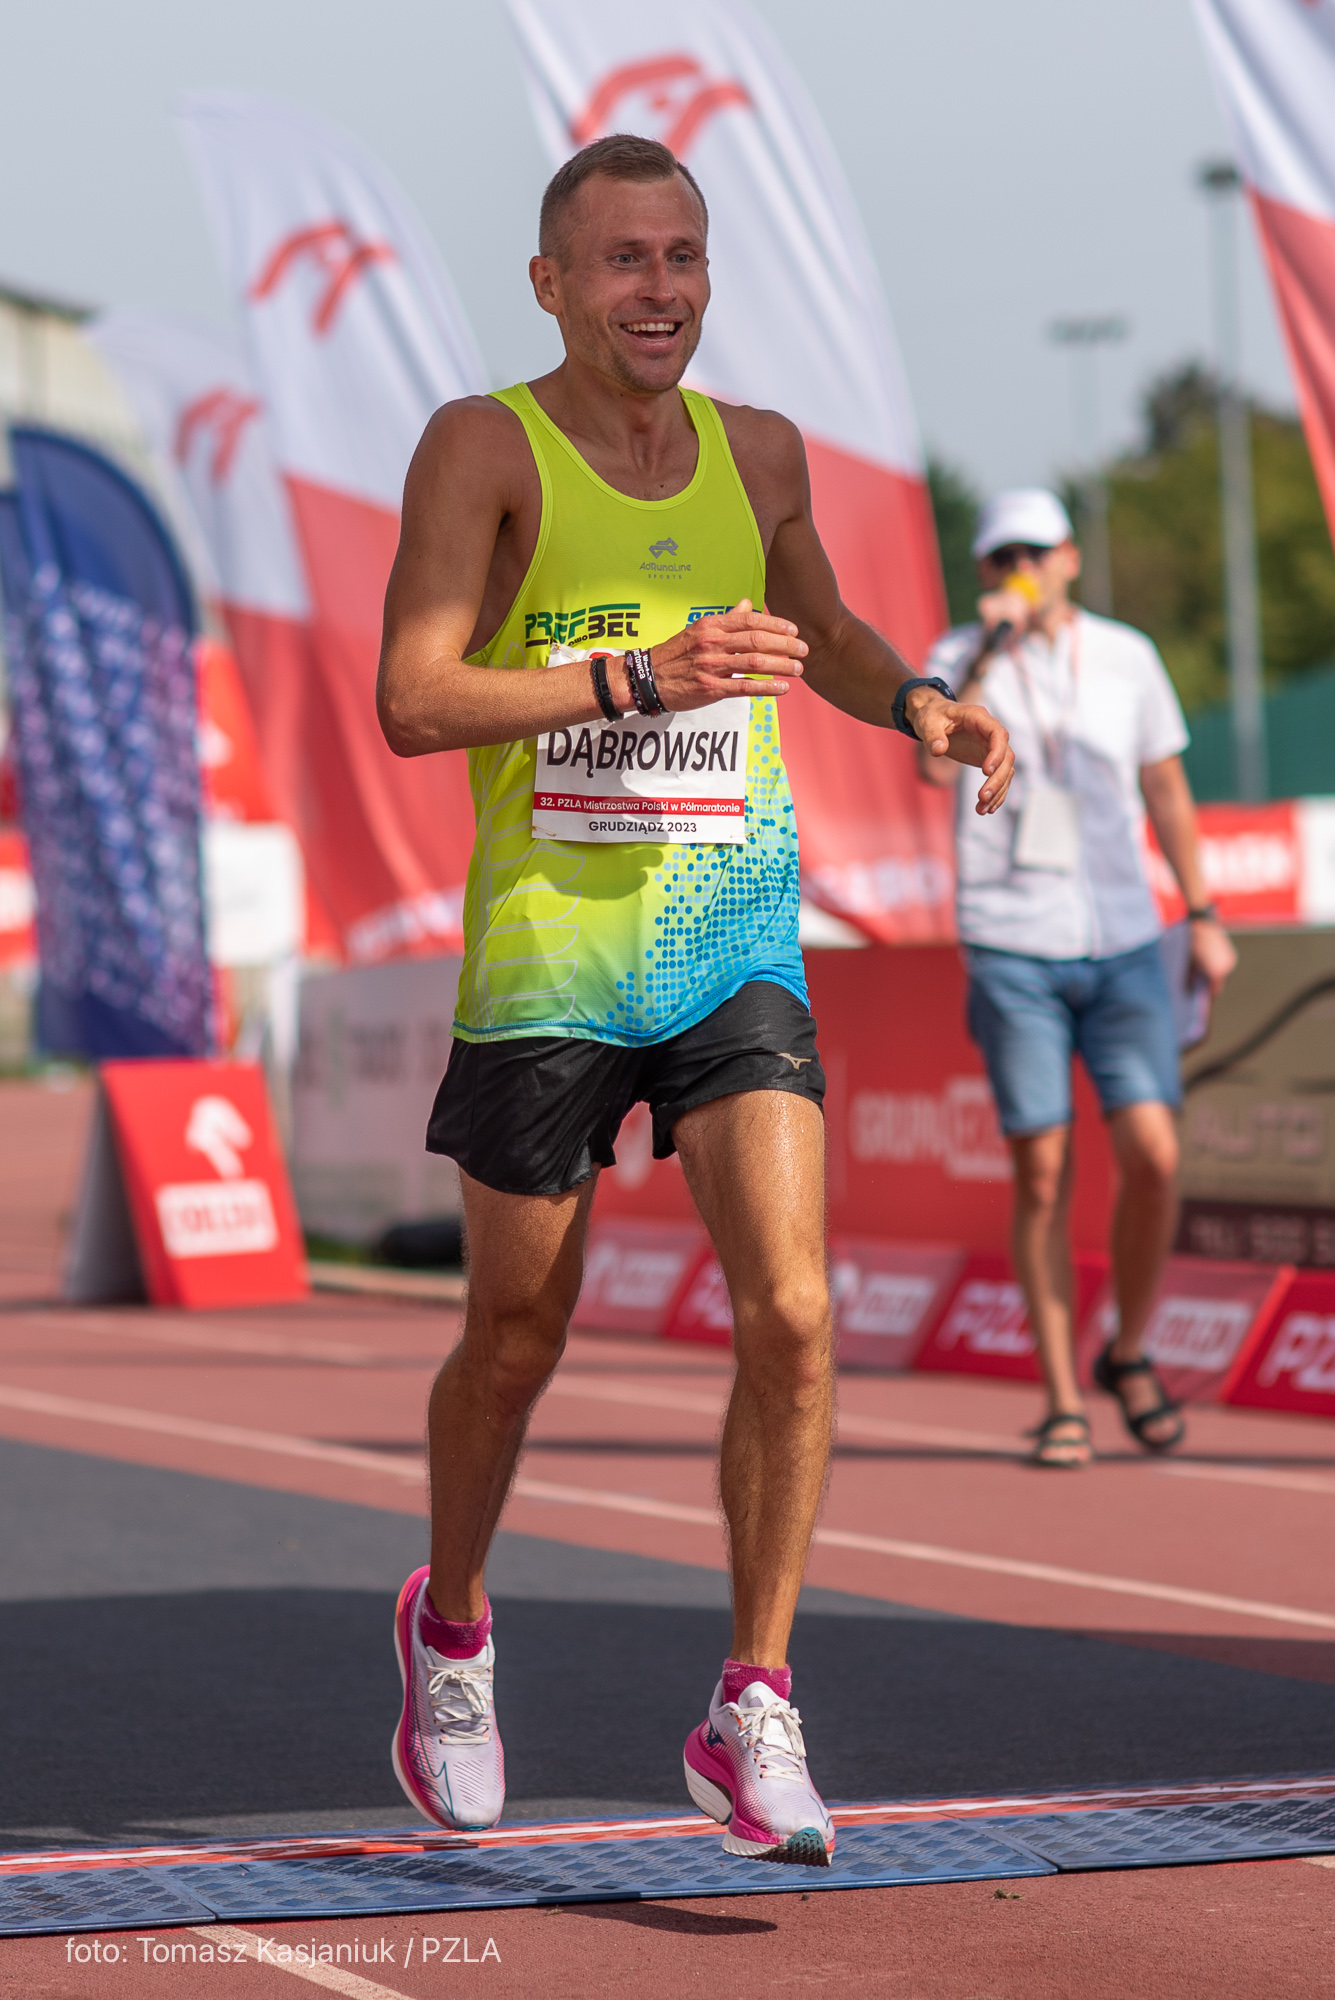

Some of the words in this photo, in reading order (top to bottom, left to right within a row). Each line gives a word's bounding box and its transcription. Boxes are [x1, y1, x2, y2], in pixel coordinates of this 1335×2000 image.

[524, 605, 641, 645] PREFBET
[546, 727, 739, 779] DĄBROWSKI
[540, 796, 556, 807] 32.
[557, 798, 582, 809] PZLA
[583, 800, 640, 811] Mistrzostwa
[641, 801, 669, 812] Polski
[670, 803, 679, 812] w
[680, 801, 741, 813] Półmaratonie
[588, 820, 665, 834] GRUDZIĄDZ
[667, 821, 697, 832] 2023
